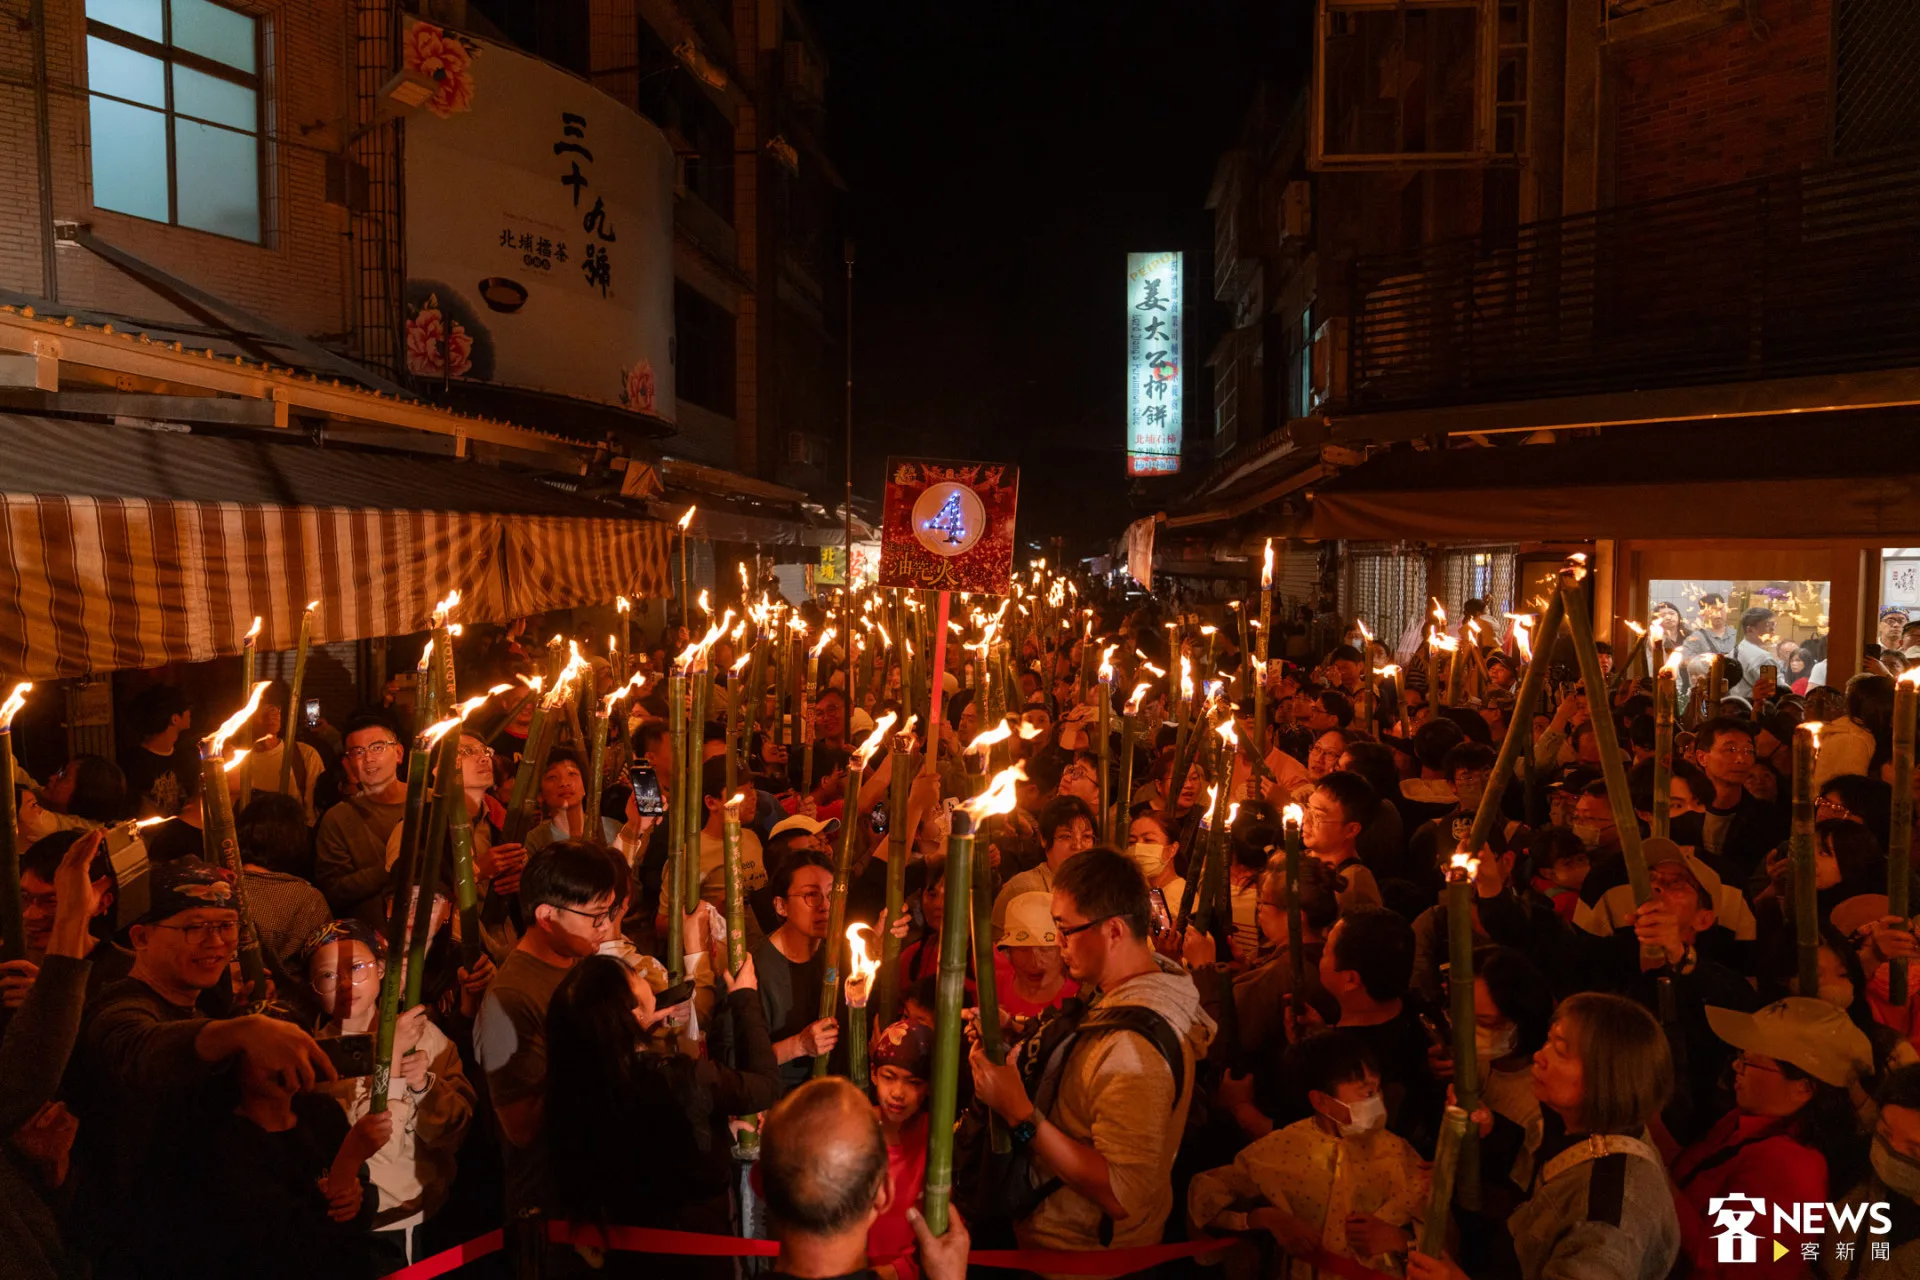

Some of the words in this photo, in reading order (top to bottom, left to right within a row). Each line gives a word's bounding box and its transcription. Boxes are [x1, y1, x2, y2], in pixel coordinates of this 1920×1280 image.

[553, 111, 617, 299] 三十九號
[499, 228, 569, 263] 北埔擂茶
[1129, 253, 1172, 282] PEIPU
[1135, 278, 1170, 429] 姜太公柿餅
[924, 489, 967, 547] 4
[821, 546, 835, 581] 北埔
